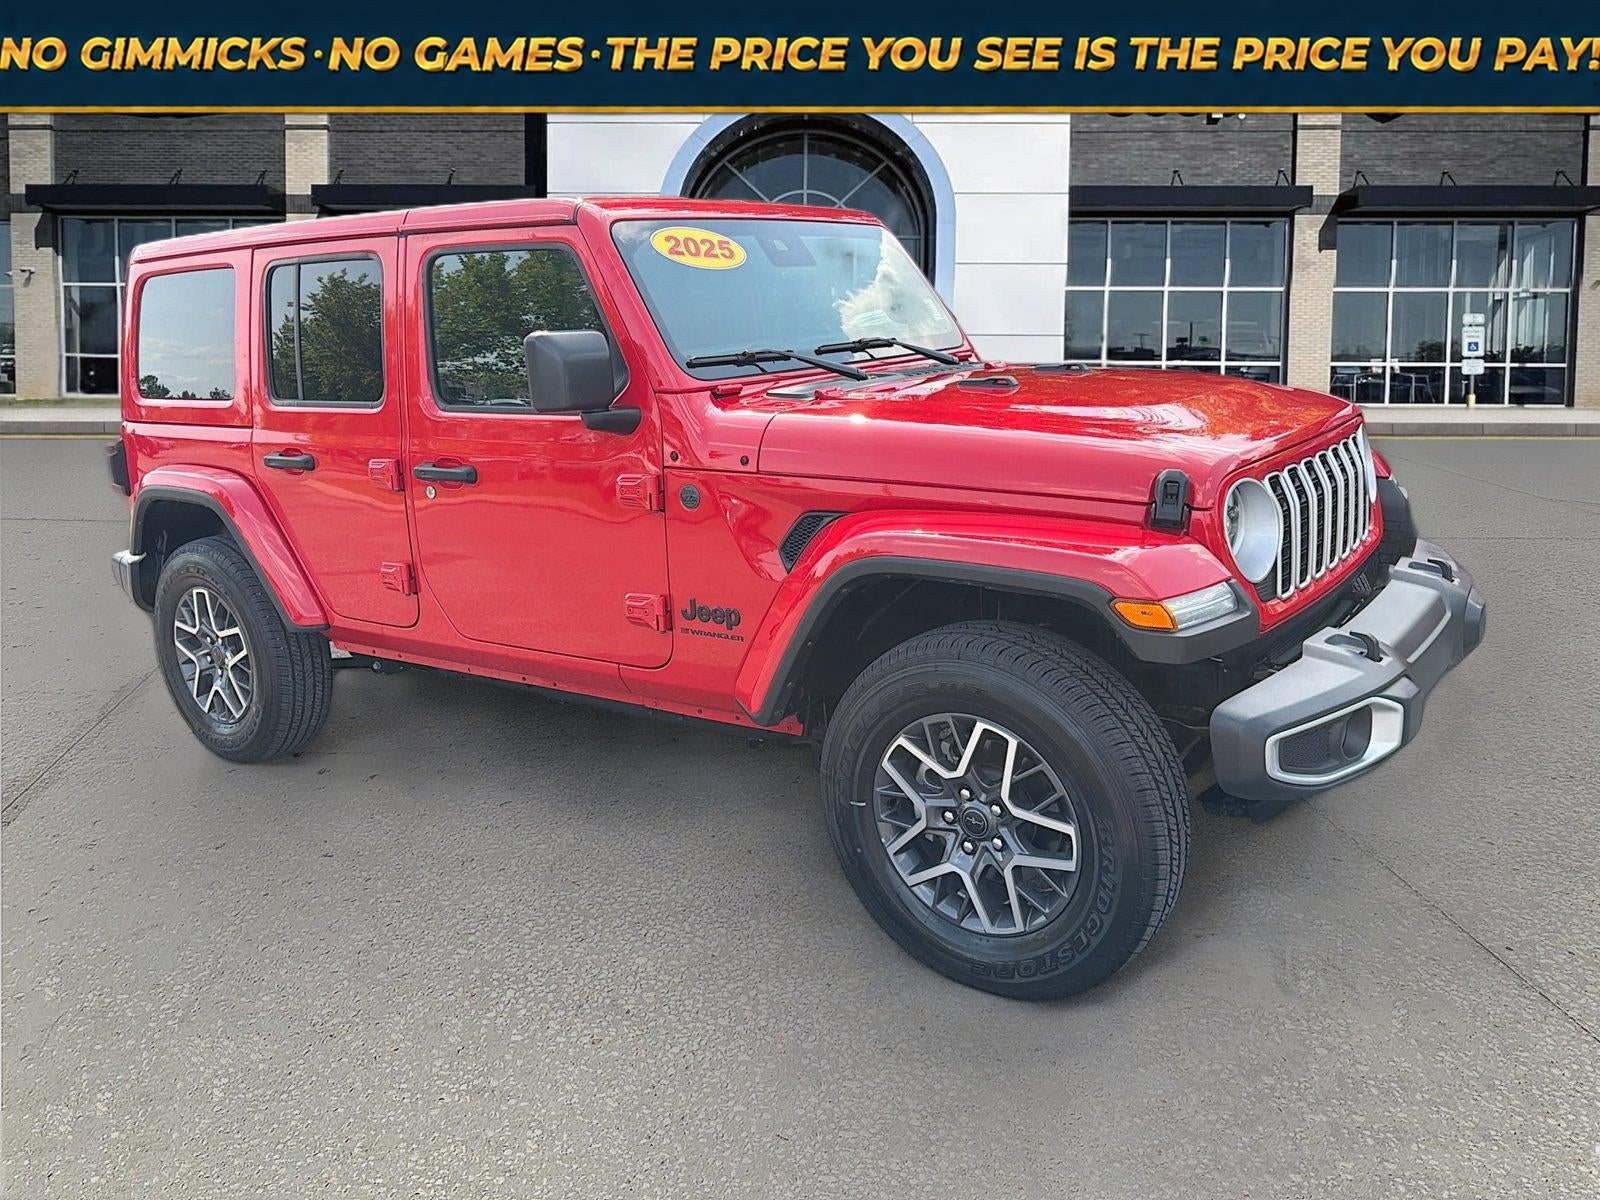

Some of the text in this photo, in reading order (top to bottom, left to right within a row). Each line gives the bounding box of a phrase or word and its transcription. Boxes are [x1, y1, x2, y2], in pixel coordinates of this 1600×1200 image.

[664, 235, 735, 260] 2025
[681, 597, 742, 631] Jeep
[689, 627, 745, 643] WRANGLER
